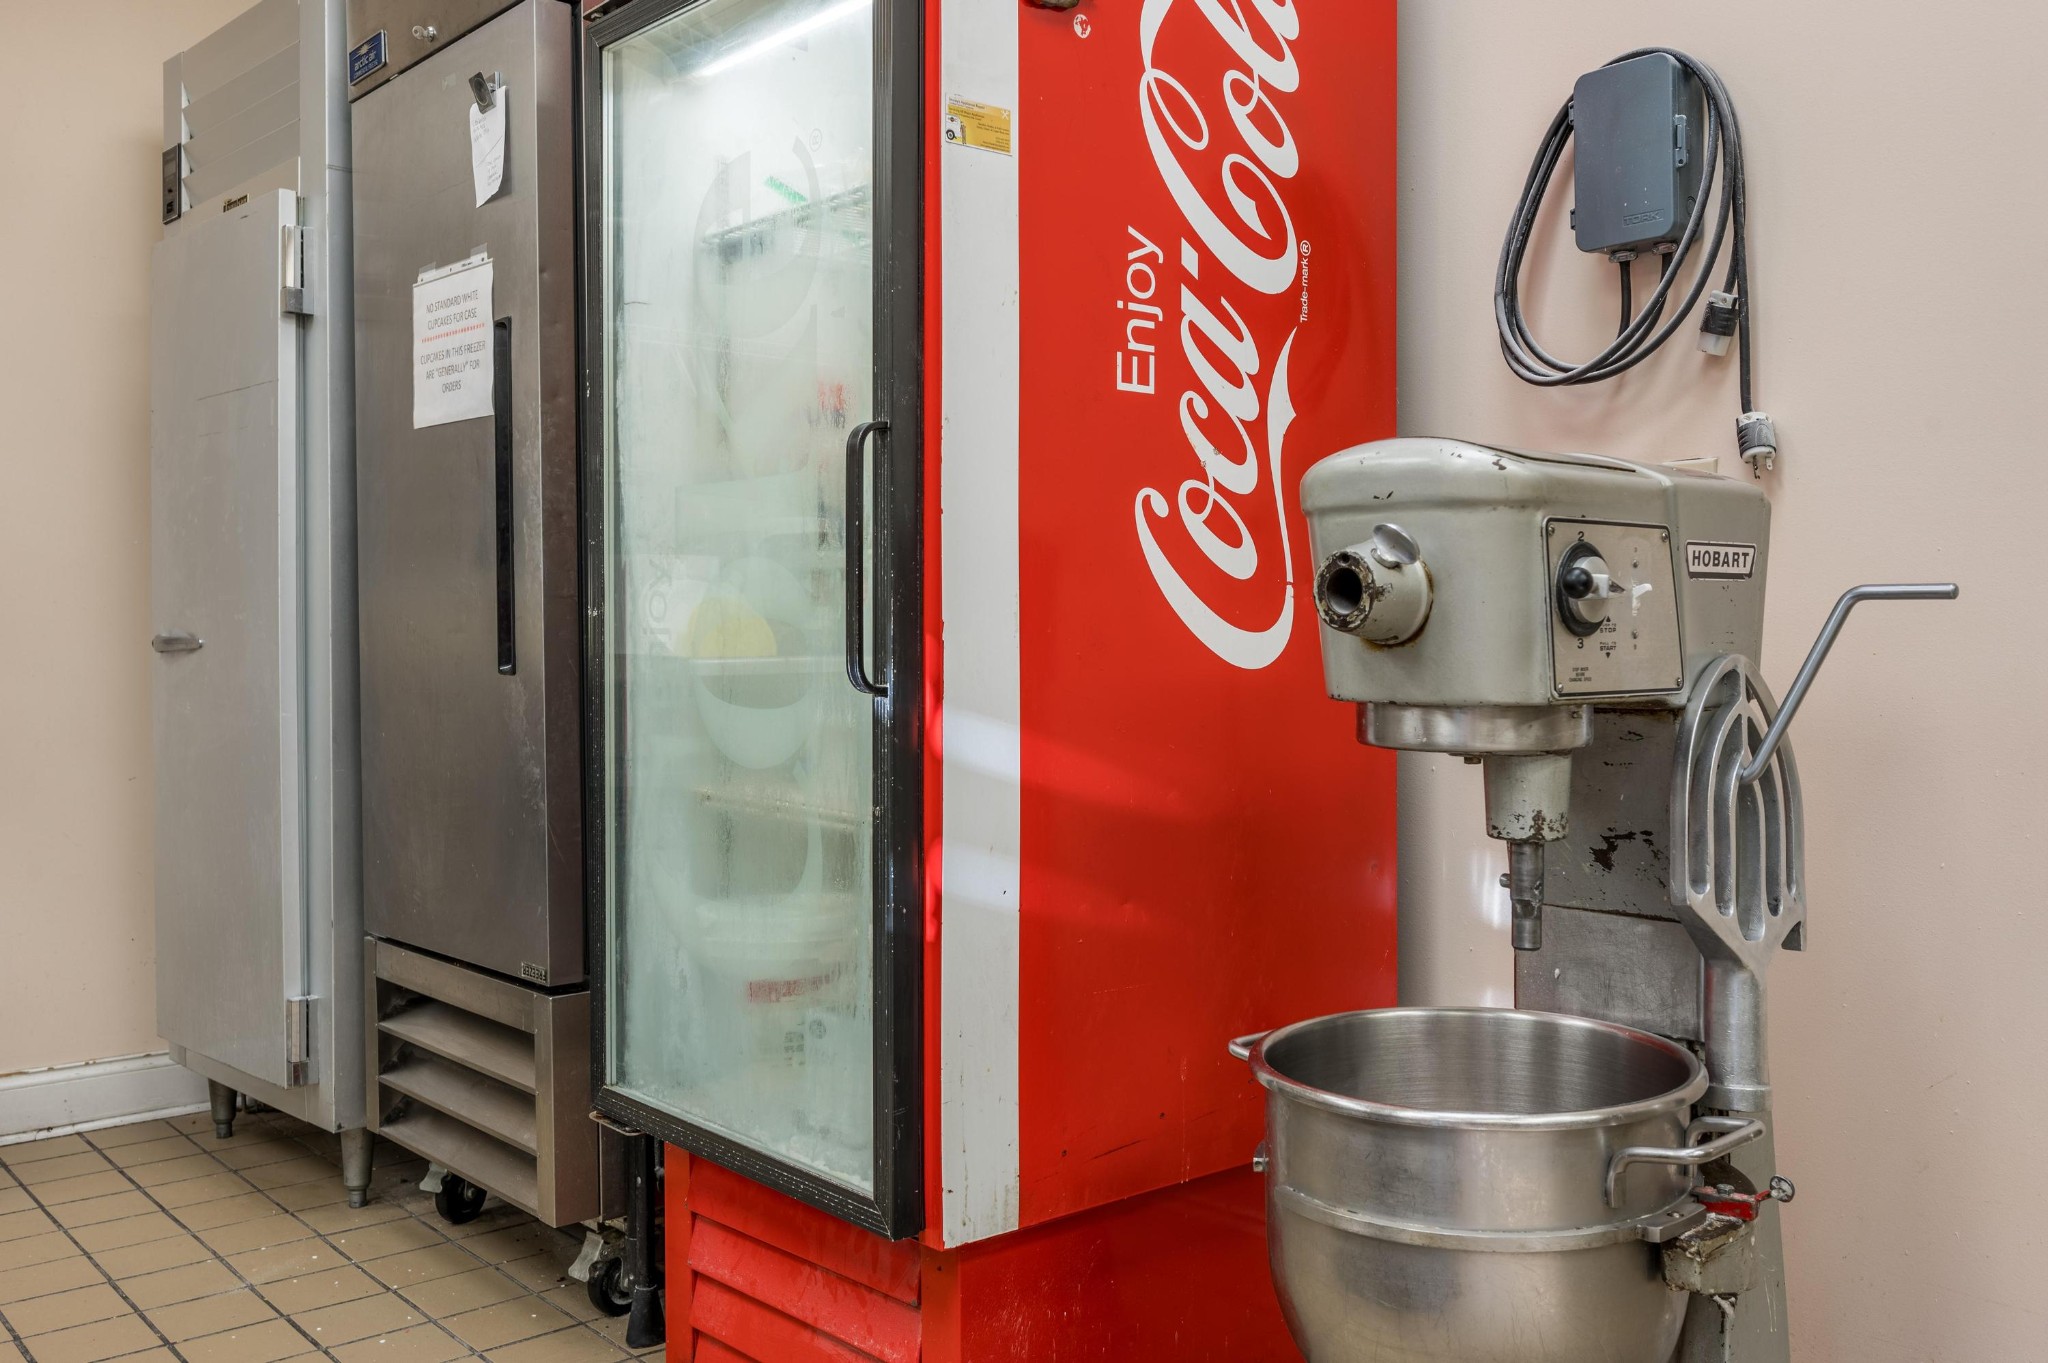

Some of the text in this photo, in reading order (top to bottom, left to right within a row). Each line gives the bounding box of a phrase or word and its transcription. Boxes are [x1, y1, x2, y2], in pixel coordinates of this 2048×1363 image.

[426, 290, 478, 314] NO STANDARD WHITE
[1117, 225, 1164, 395] Enjoy
[428, 308, 477, 330] CUPCAKES FOR CASE
[1135, 0, 1300, 670] Coca-Col
[420, 340, 486, 365] CUPCAKES IN THIS FREEZER
[426, 369, 435, 380] ARE
[469, 359, 480, 370] FOR
[441, 380, 462, 393] ORDERS
[1577, 531, 1585, 541] 2
[1692, 550, 1749, 568] HOBART
[1577, 637, 1584, 649] 3
[523, 965, 547, 981] FREEZER
